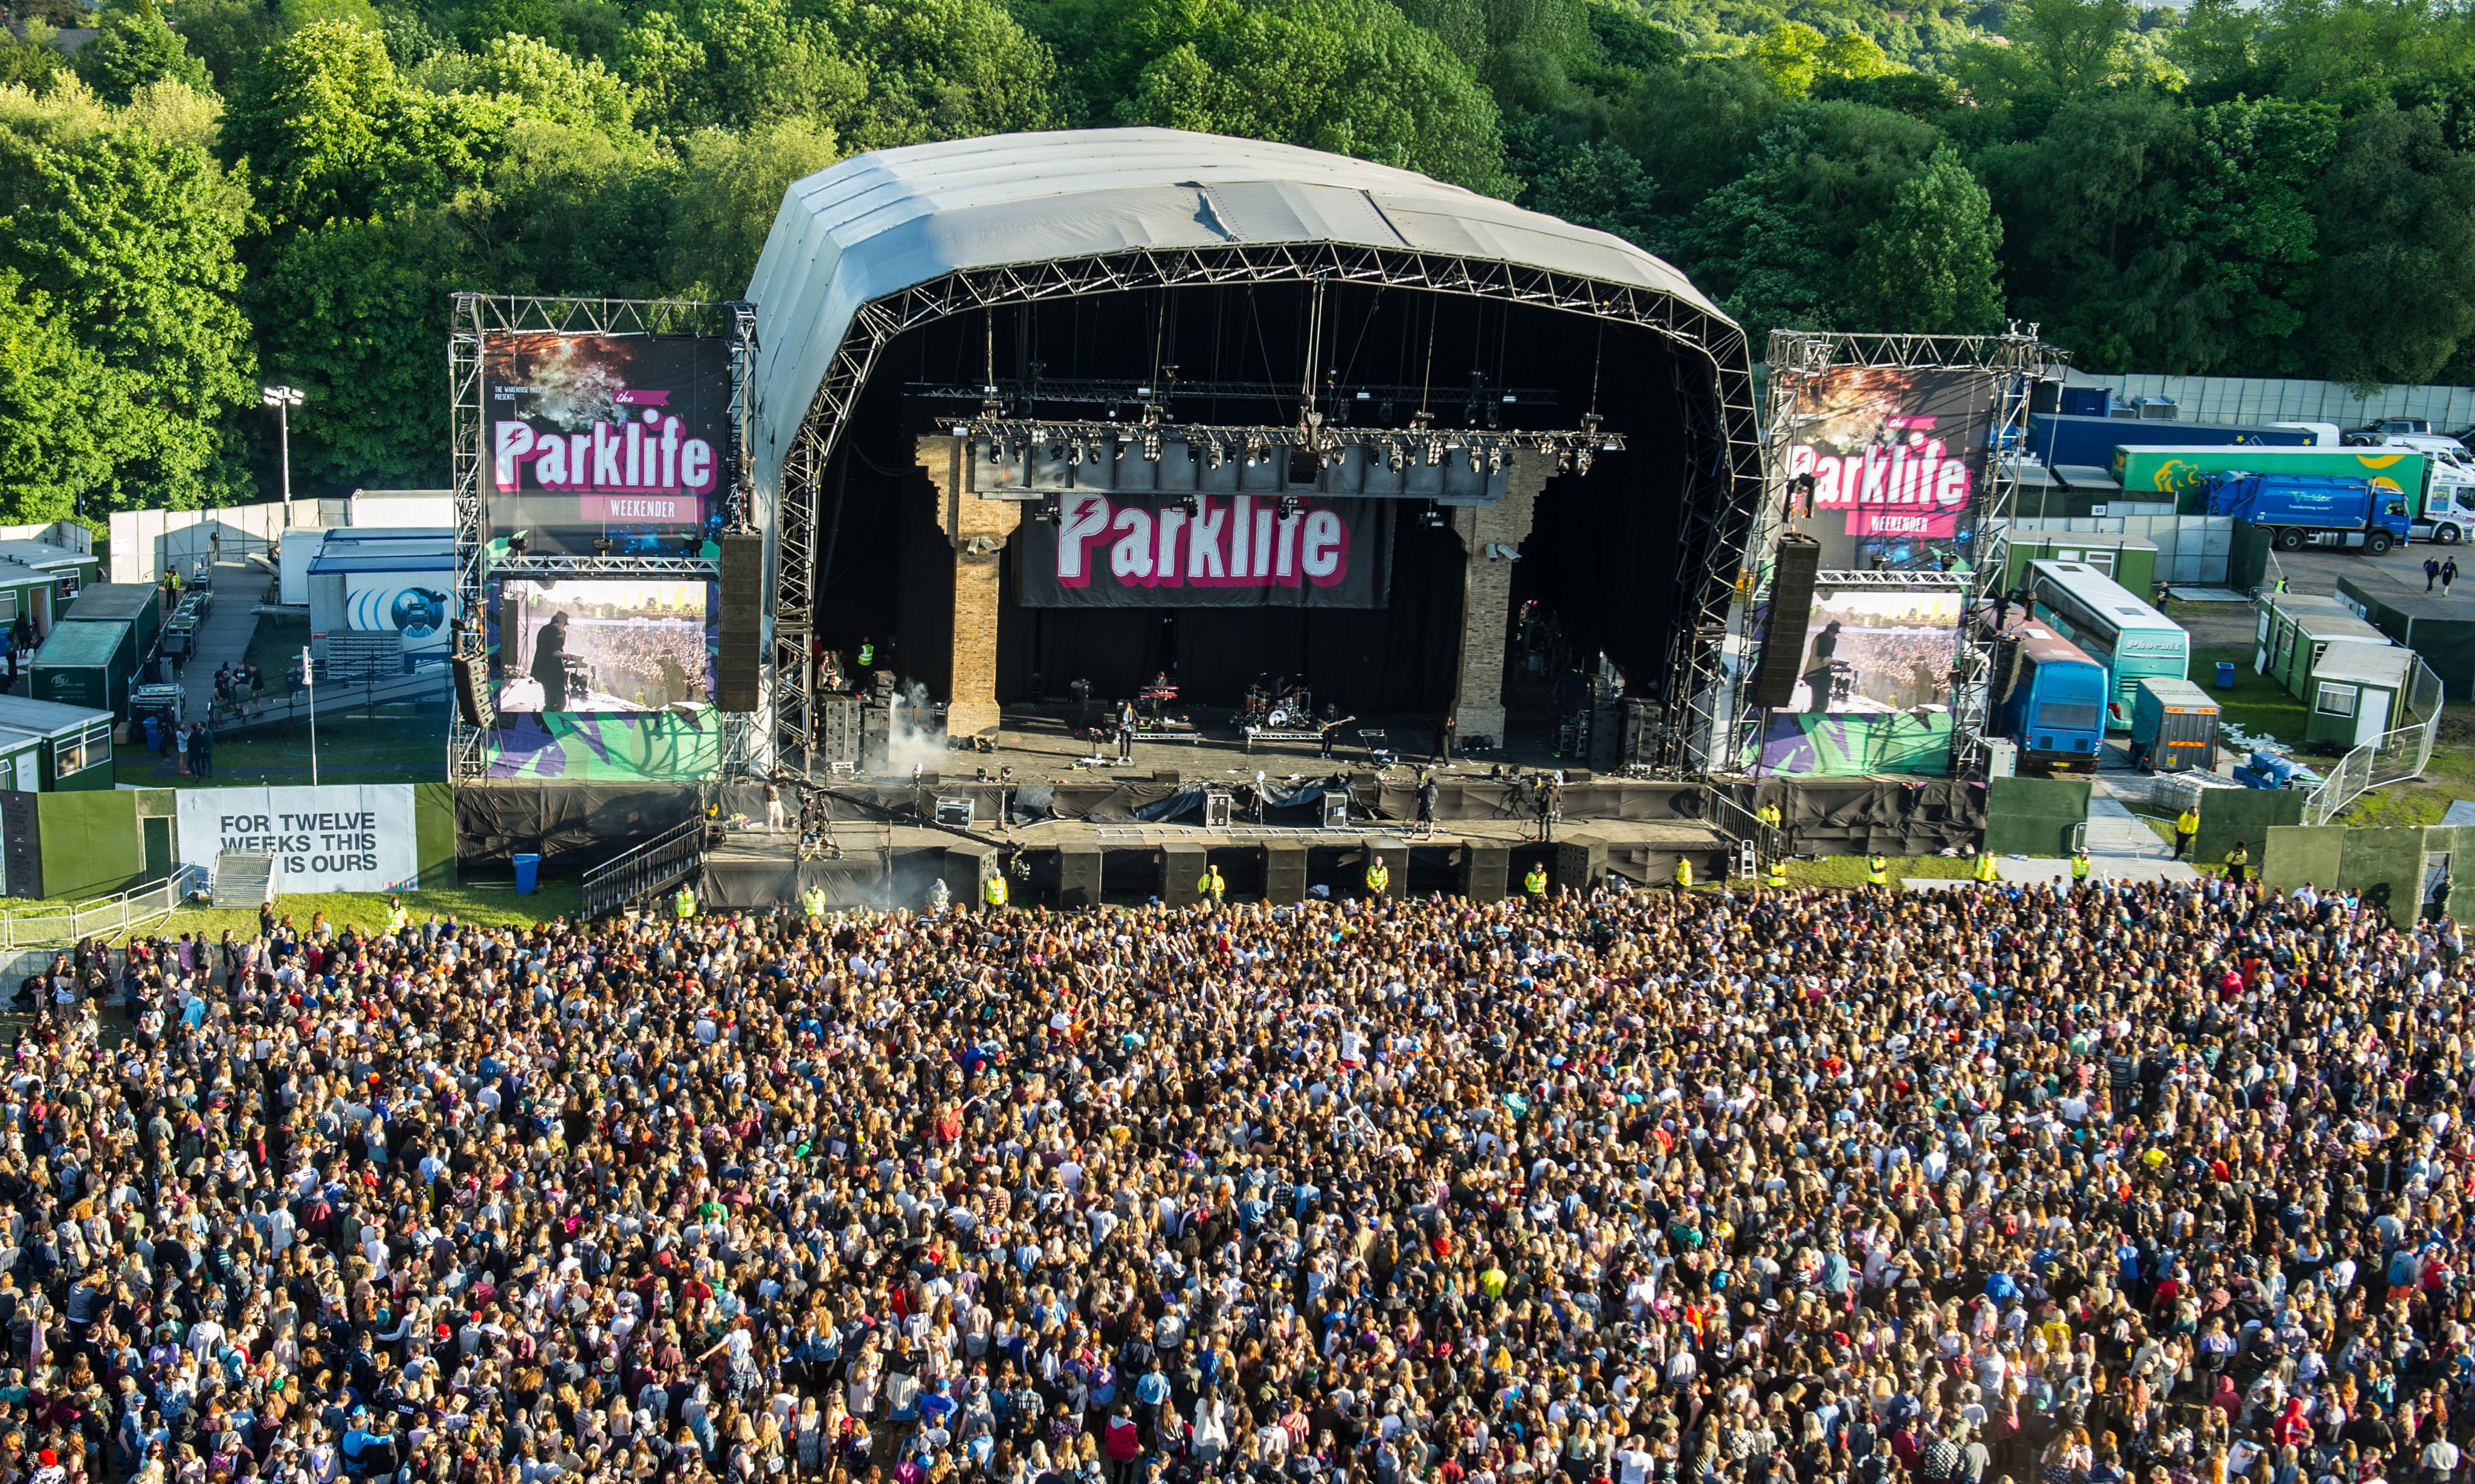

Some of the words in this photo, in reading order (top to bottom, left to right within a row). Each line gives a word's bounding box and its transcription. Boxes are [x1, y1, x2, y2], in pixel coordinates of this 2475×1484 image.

[616, 391, 633, 403] the
[1888, 416, 1905, 427] the
[495, 408, 711, 488] Parklife
[1782, 431, 1966, 505] Parklife
[611, 499, 675, 518] WEEKENDER
[1871, 515, 1929, 532] WEEKENDER
[1057, 492, 1341, 578] Parklife
[2126, 640, 2183, 651] Phoenix
[221, 815, 269, 833] FOR
[279, 812, 376, 831] TWELVE
[221, 835, 311, 853] WEEKS
[320, 833, 376, 851] THIS
[285, 856, 305, 873] IS
[312, 854, 378, 873] OURS
